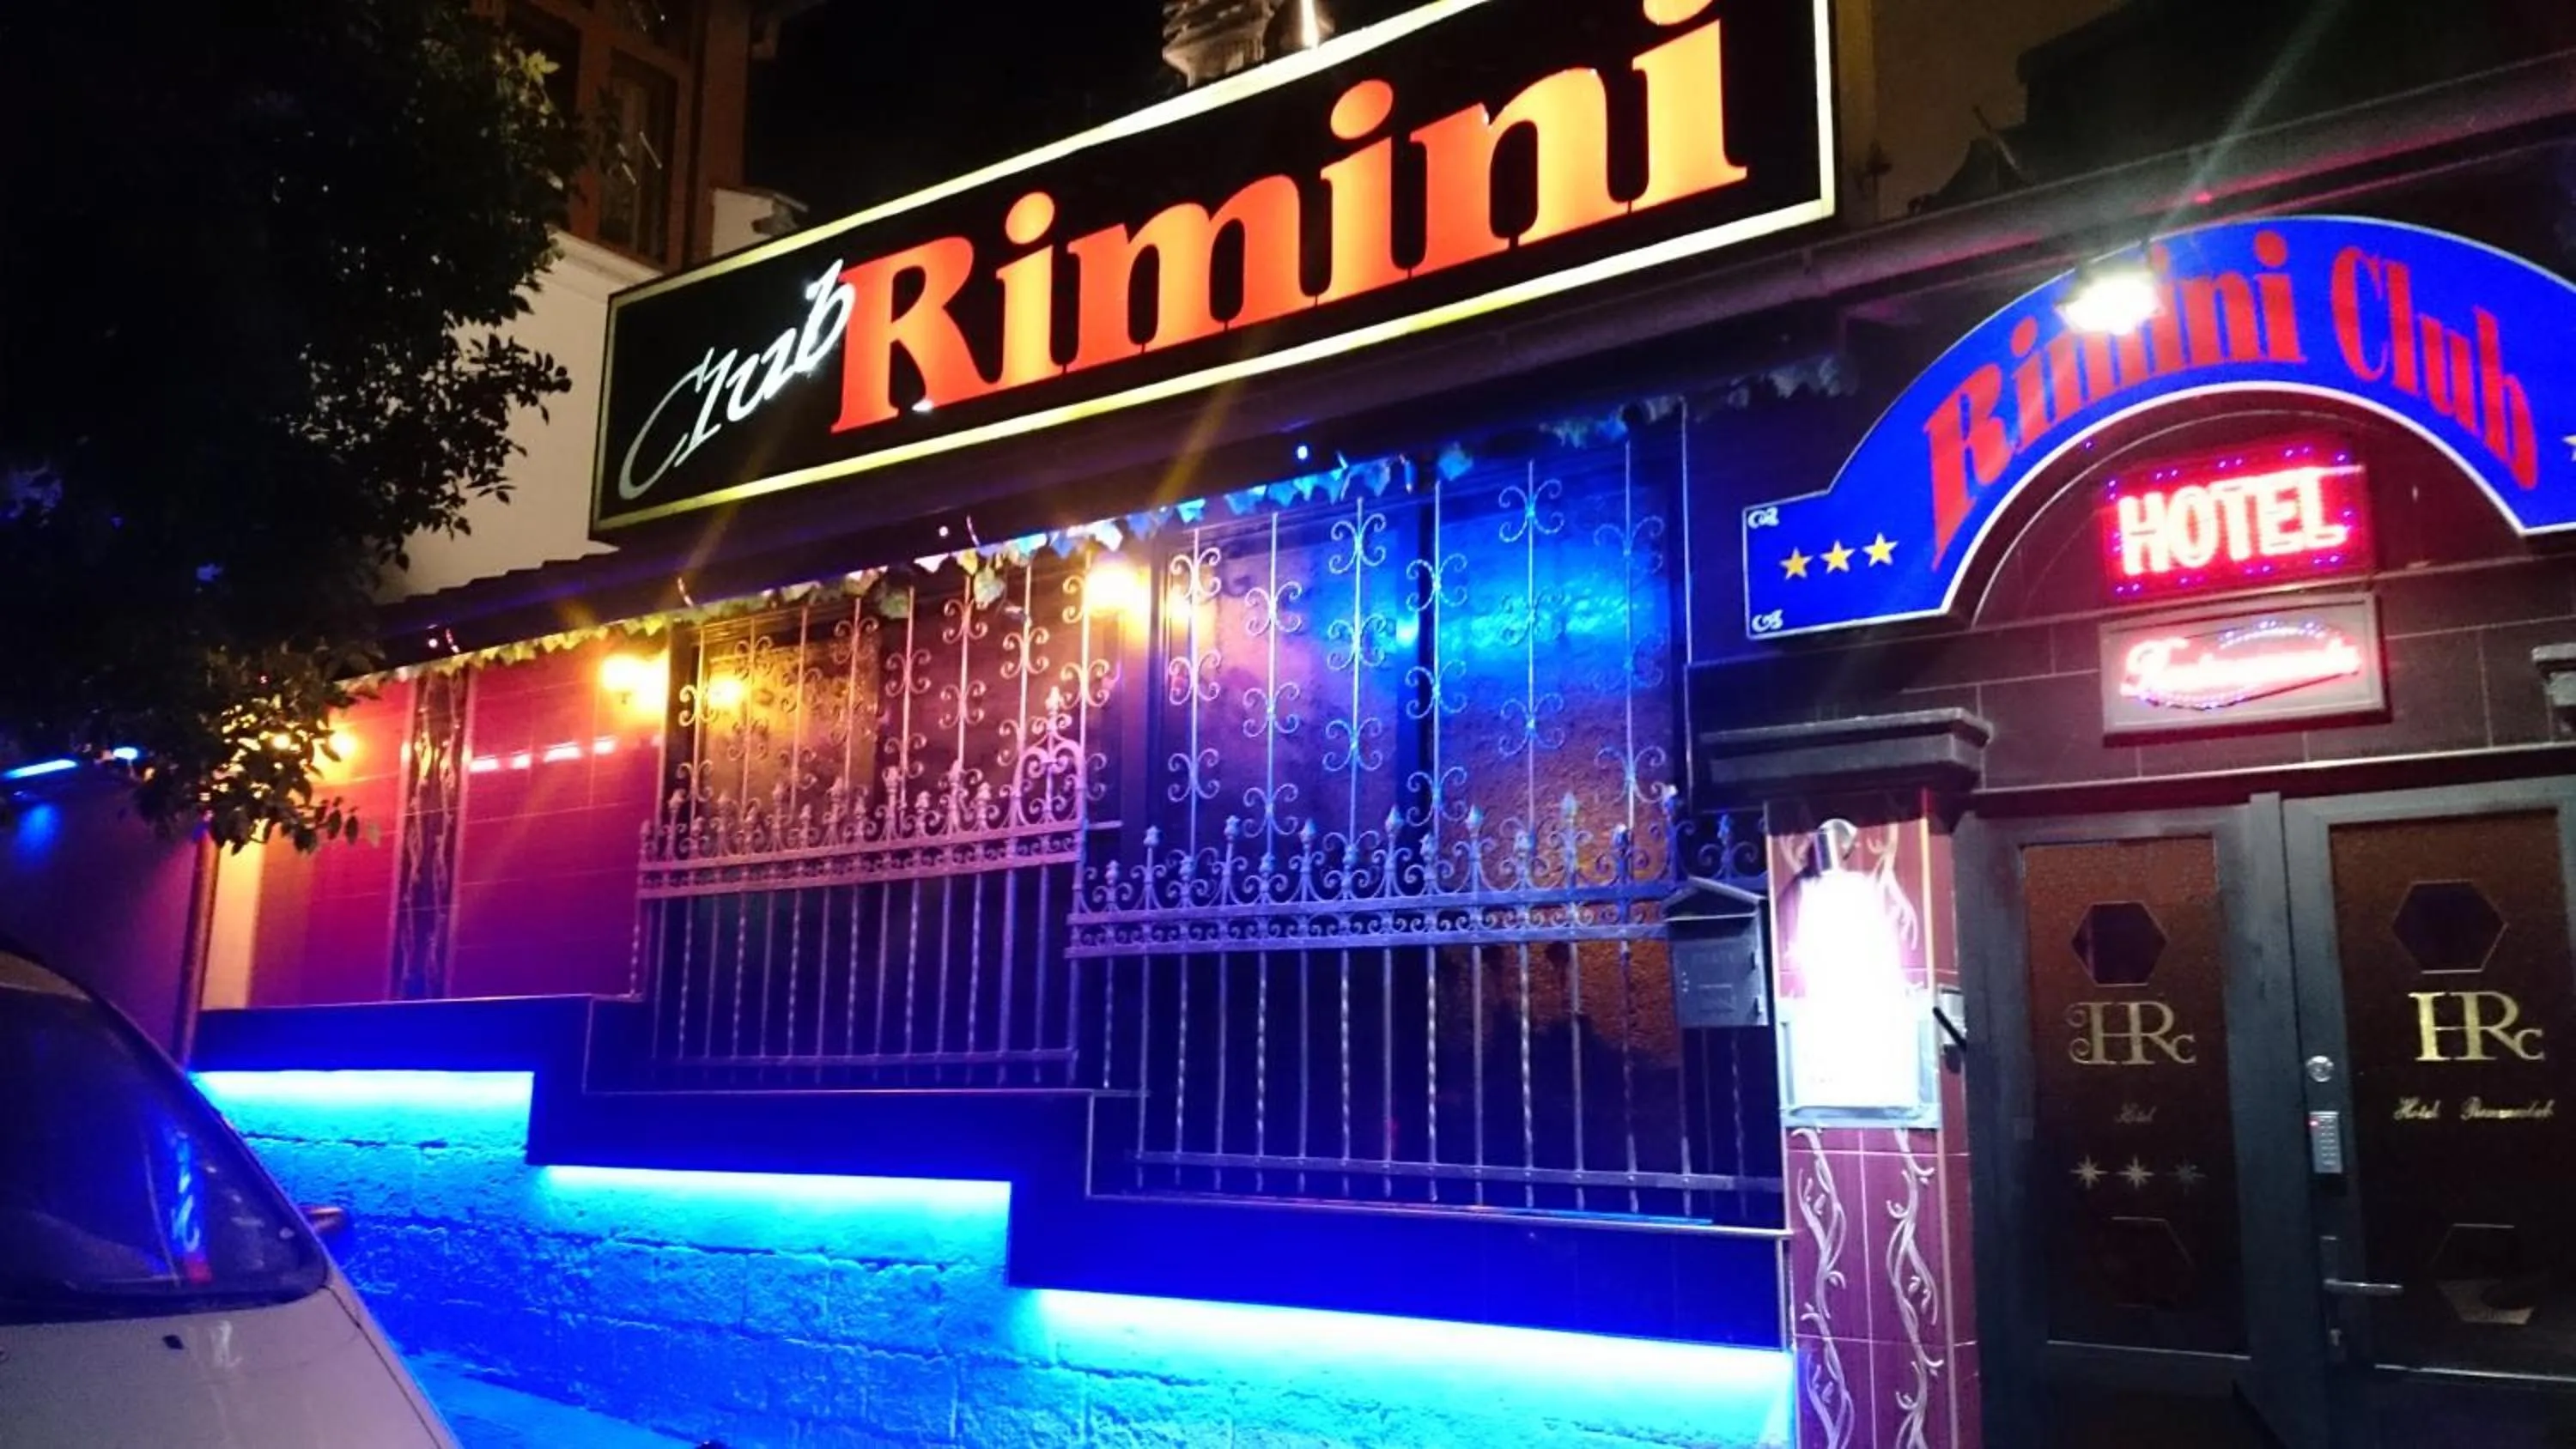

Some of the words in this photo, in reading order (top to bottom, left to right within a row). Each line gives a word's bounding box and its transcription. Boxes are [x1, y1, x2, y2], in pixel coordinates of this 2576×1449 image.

[617, 258, 856, 500] Club
[829, 0, 1747, 434] Rimini
[1923, 229, 2308, 572] Rimini
[2330, 246, 2538, 490] Club
[2117, 466, 2349, 576] HOTEL
